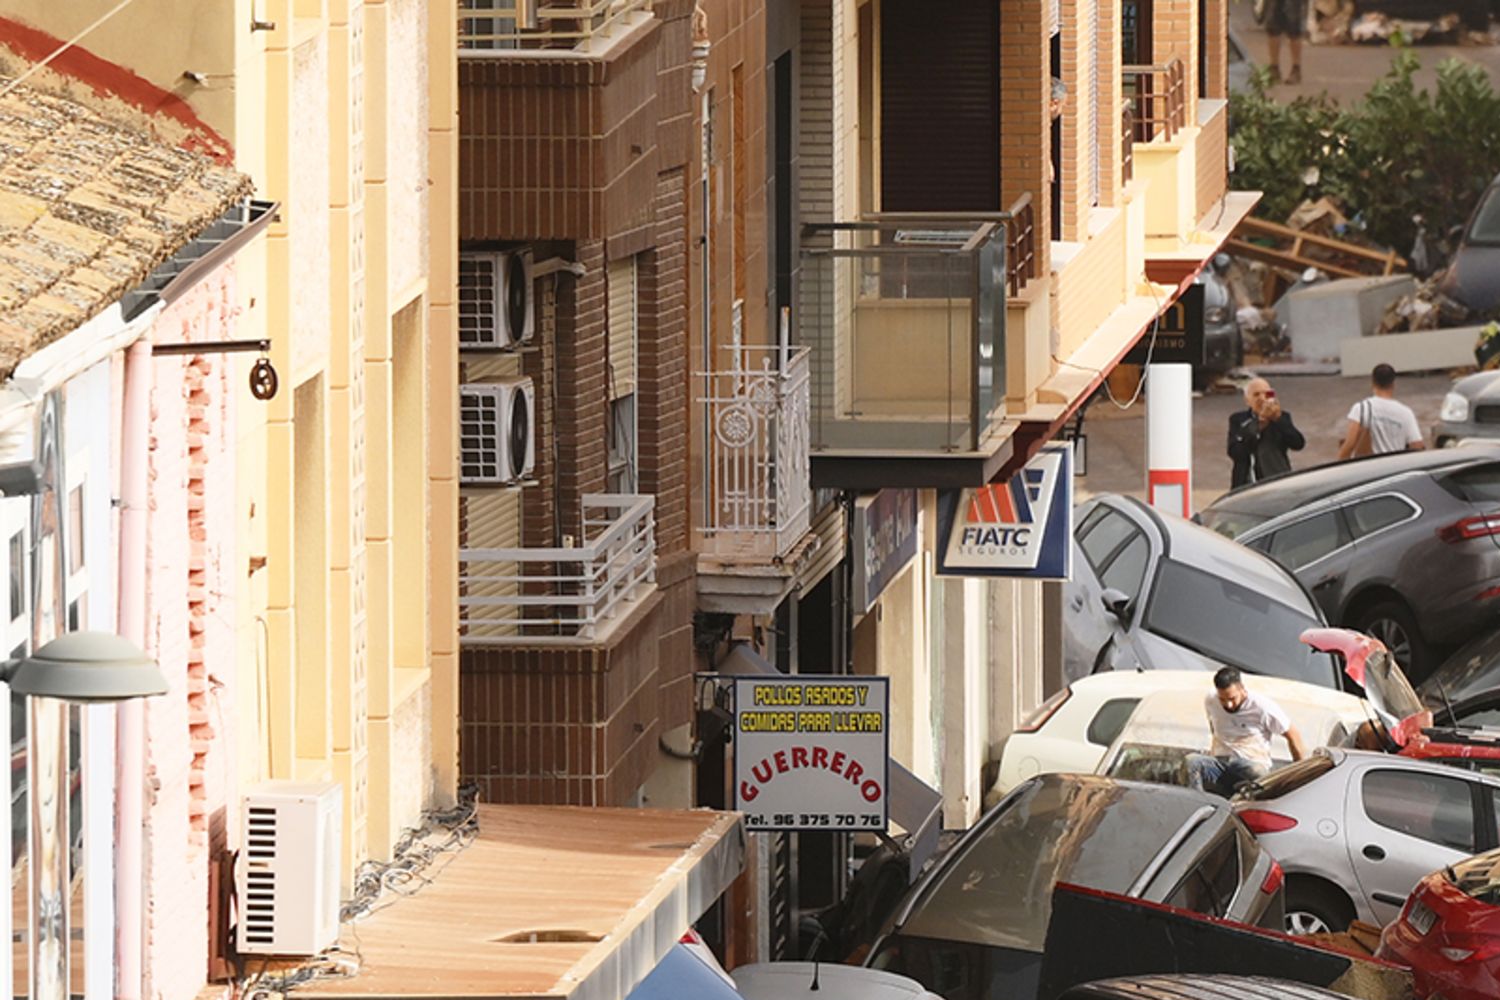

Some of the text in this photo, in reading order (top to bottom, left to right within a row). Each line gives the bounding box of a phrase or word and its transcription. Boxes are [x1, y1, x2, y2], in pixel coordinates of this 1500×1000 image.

[961, 527, 1031, 547] FIATC
[958, 546, 1028, 556] SEGUROS
[754, 685, 869, 706] POLLOS ASADOS Y
[740, 711, 882, 733] COMIDAS PARA LLEVAR
[740, 746, 882, 803] GUERRERO
[744, 814, 881, 826] Tel. 96 375 70 76
